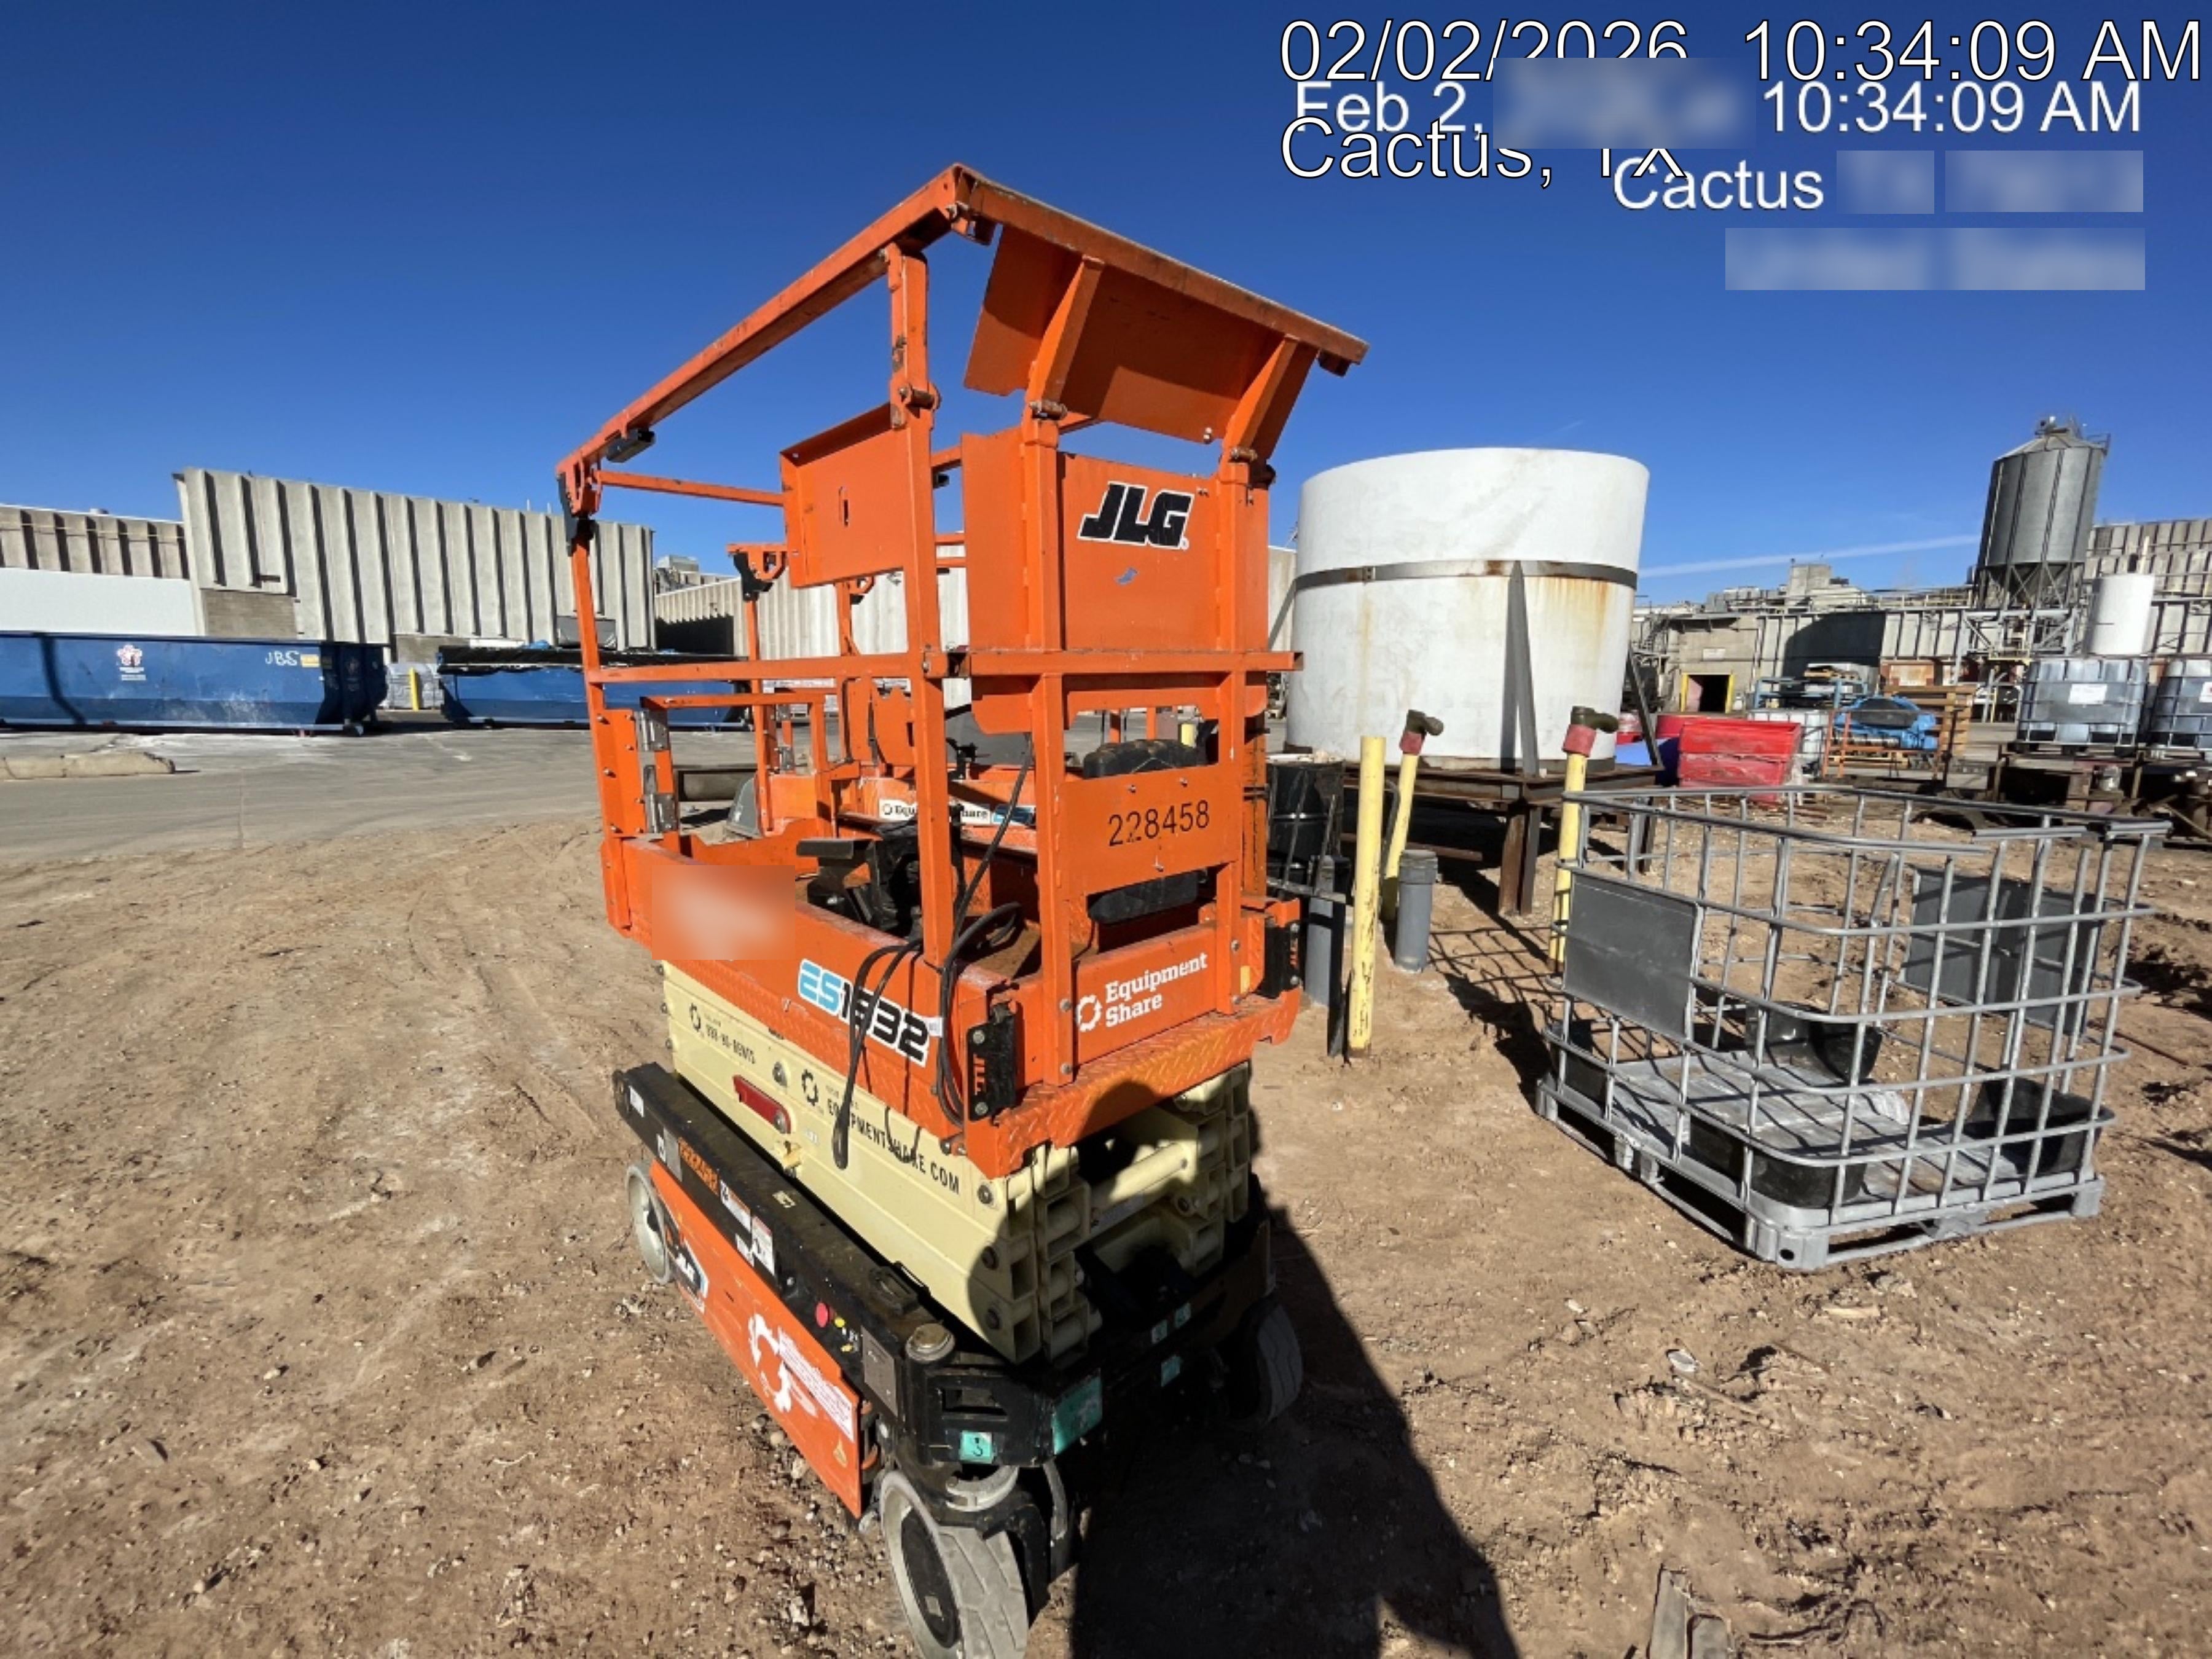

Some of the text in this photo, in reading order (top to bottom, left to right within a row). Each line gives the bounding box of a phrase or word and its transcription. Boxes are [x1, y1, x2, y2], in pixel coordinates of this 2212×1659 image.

[1077, 480, 1194, 549] JLG
[265, 650, 299, 666] JBS
[1108, 799, 1210, 847] 228458
[1105, 952, 1208, 1003] Equipment
[1105, 994, 1163, 1028] Share
